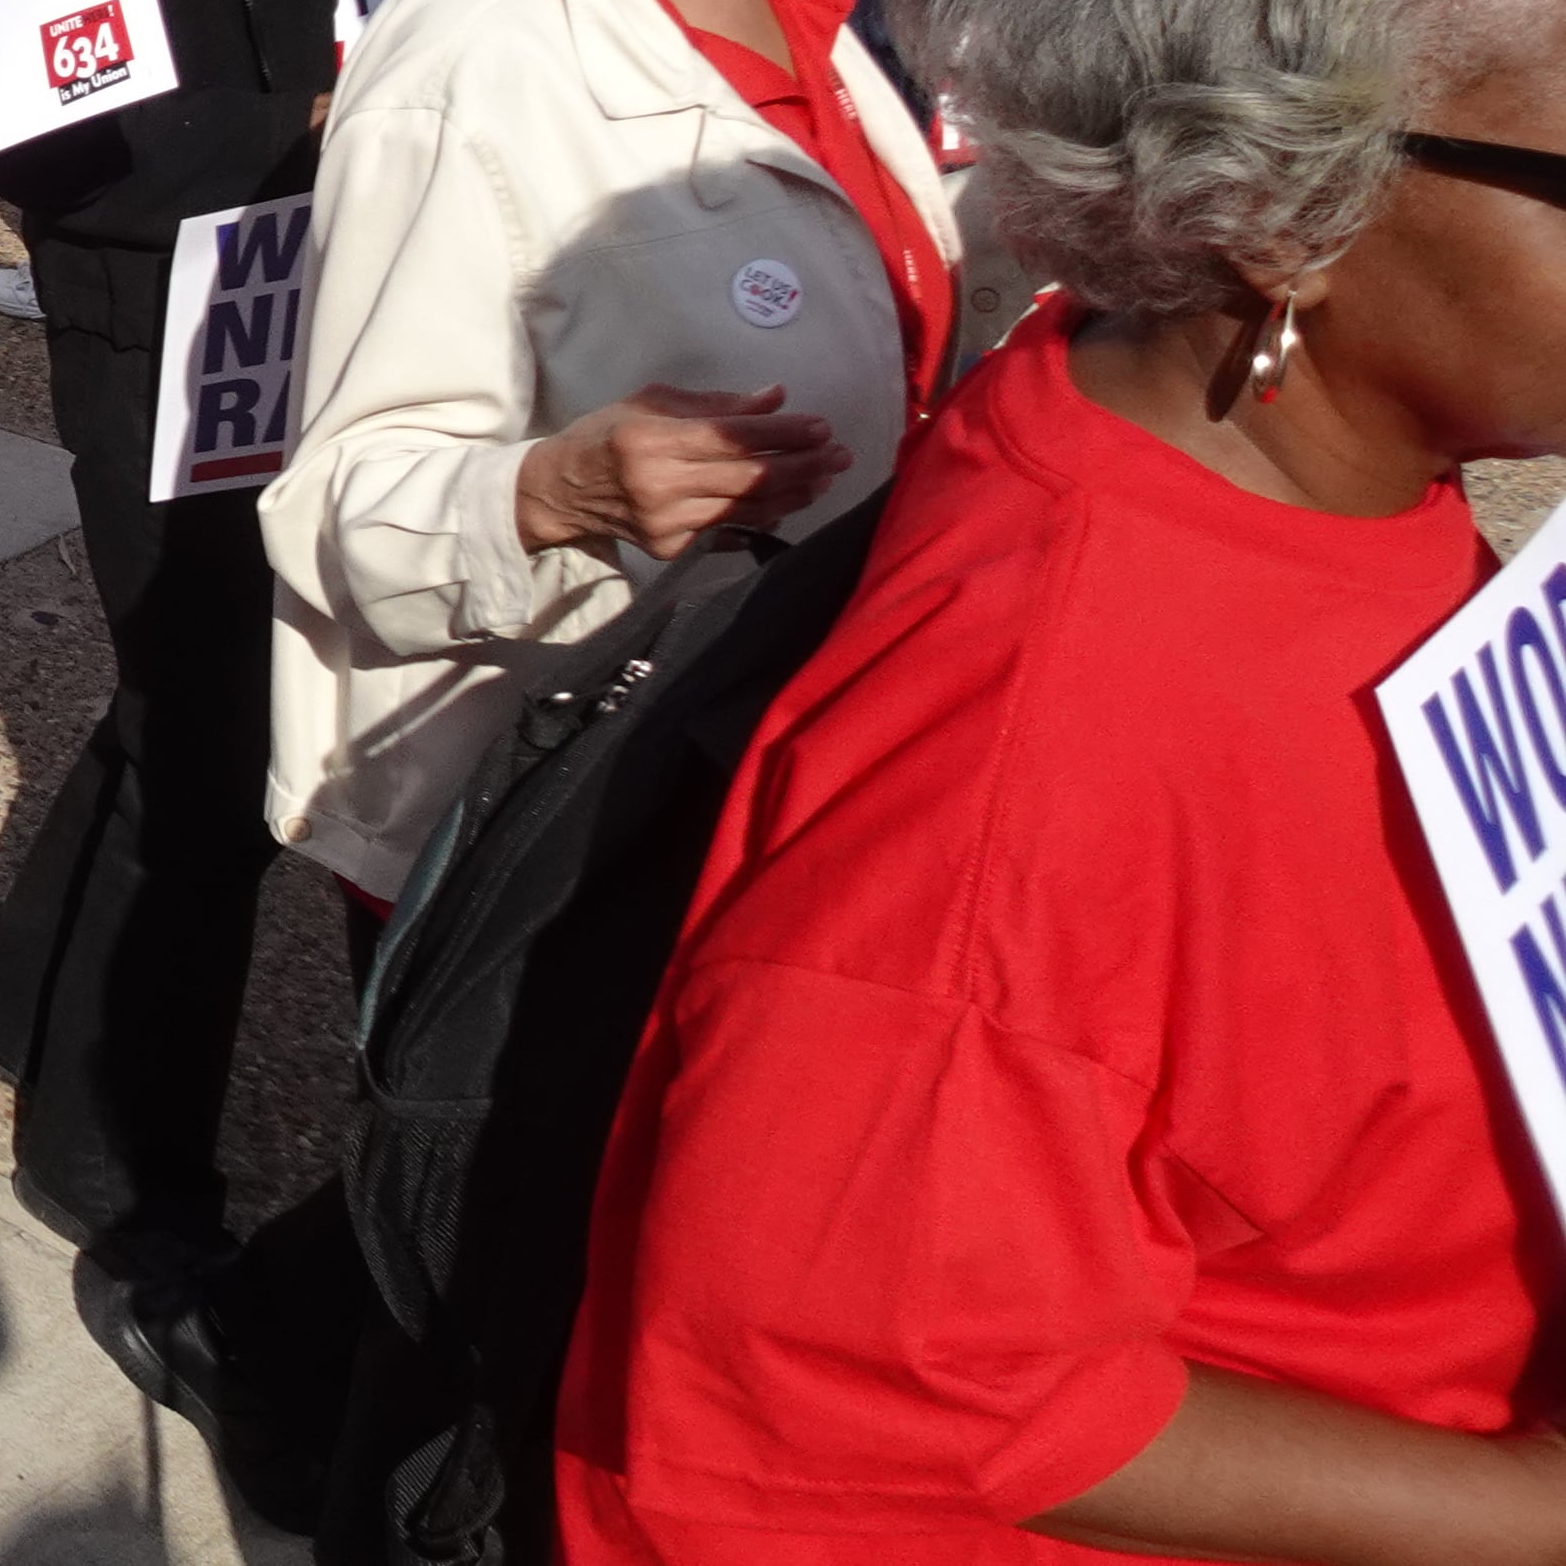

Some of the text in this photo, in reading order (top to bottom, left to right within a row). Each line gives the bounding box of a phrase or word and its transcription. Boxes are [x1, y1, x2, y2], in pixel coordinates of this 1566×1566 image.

[53, 22, 120, 80] 634
[59, 67, 128, 102] is My Union
